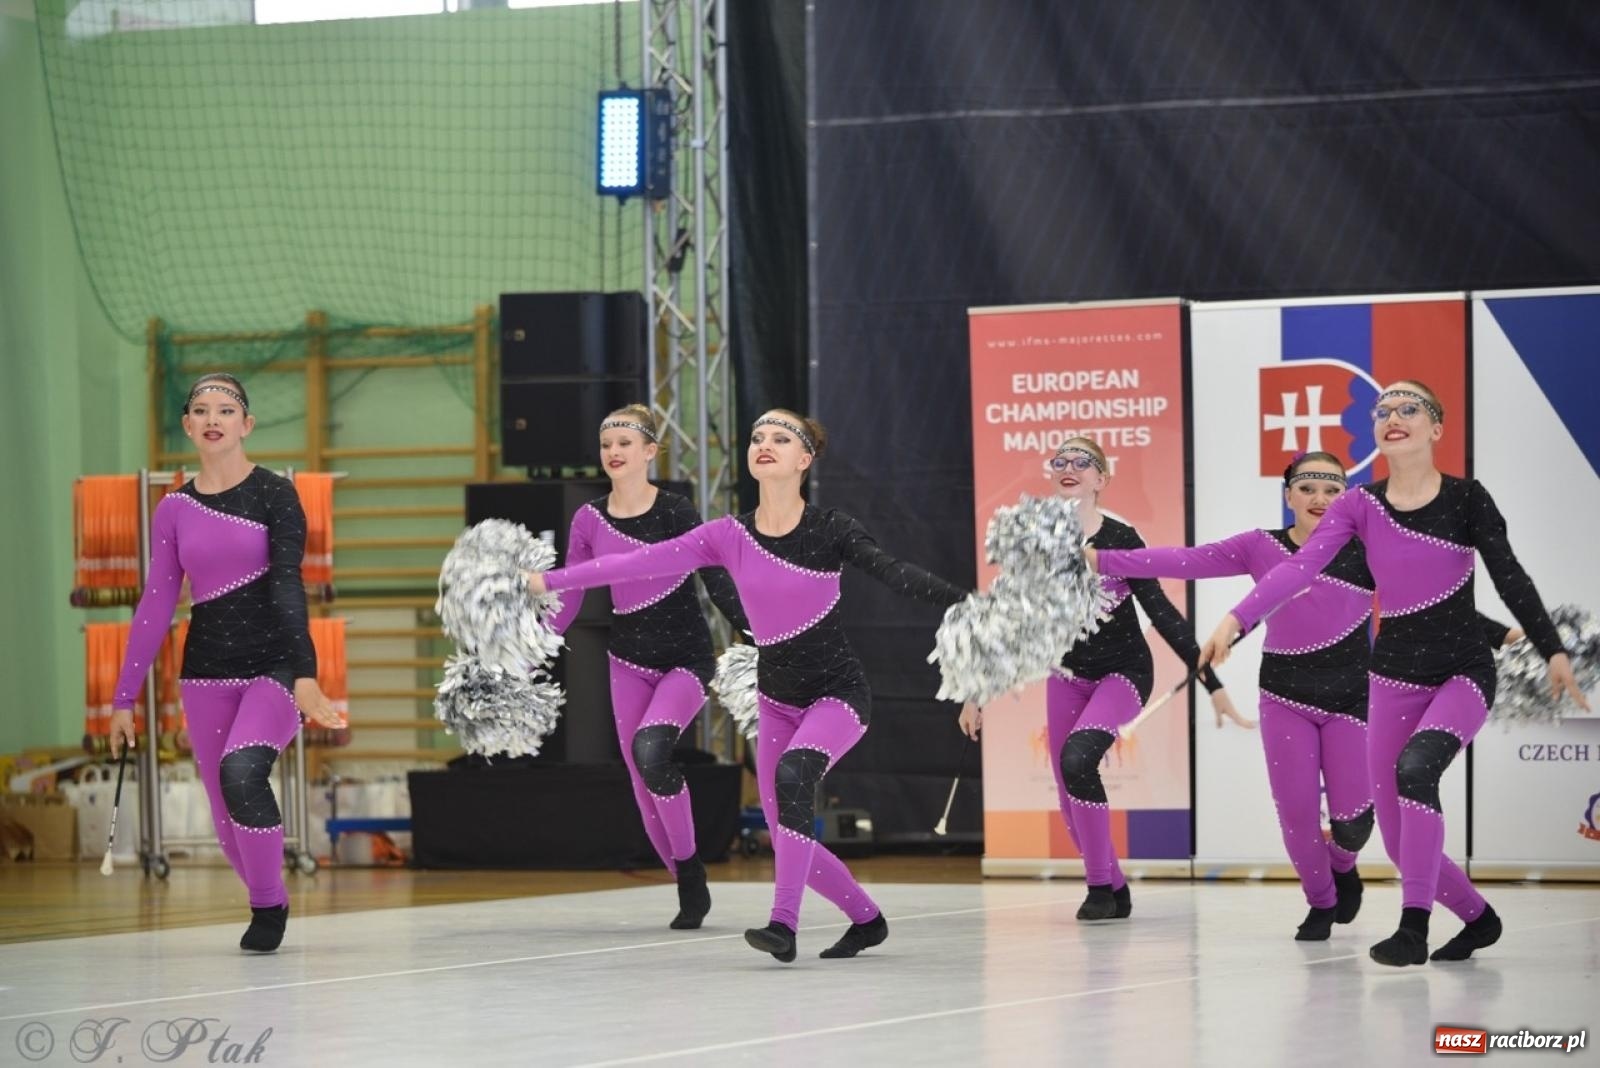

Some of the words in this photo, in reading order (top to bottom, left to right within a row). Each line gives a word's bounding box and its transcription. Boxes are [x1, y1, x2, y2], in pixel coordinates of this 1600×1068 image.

[1012, 369, 1139, 394] EUROPEAN
[985, 397, 1168, 425] CHAMPIONSHIP
[1518, 744, 1590, 761] CZECH
